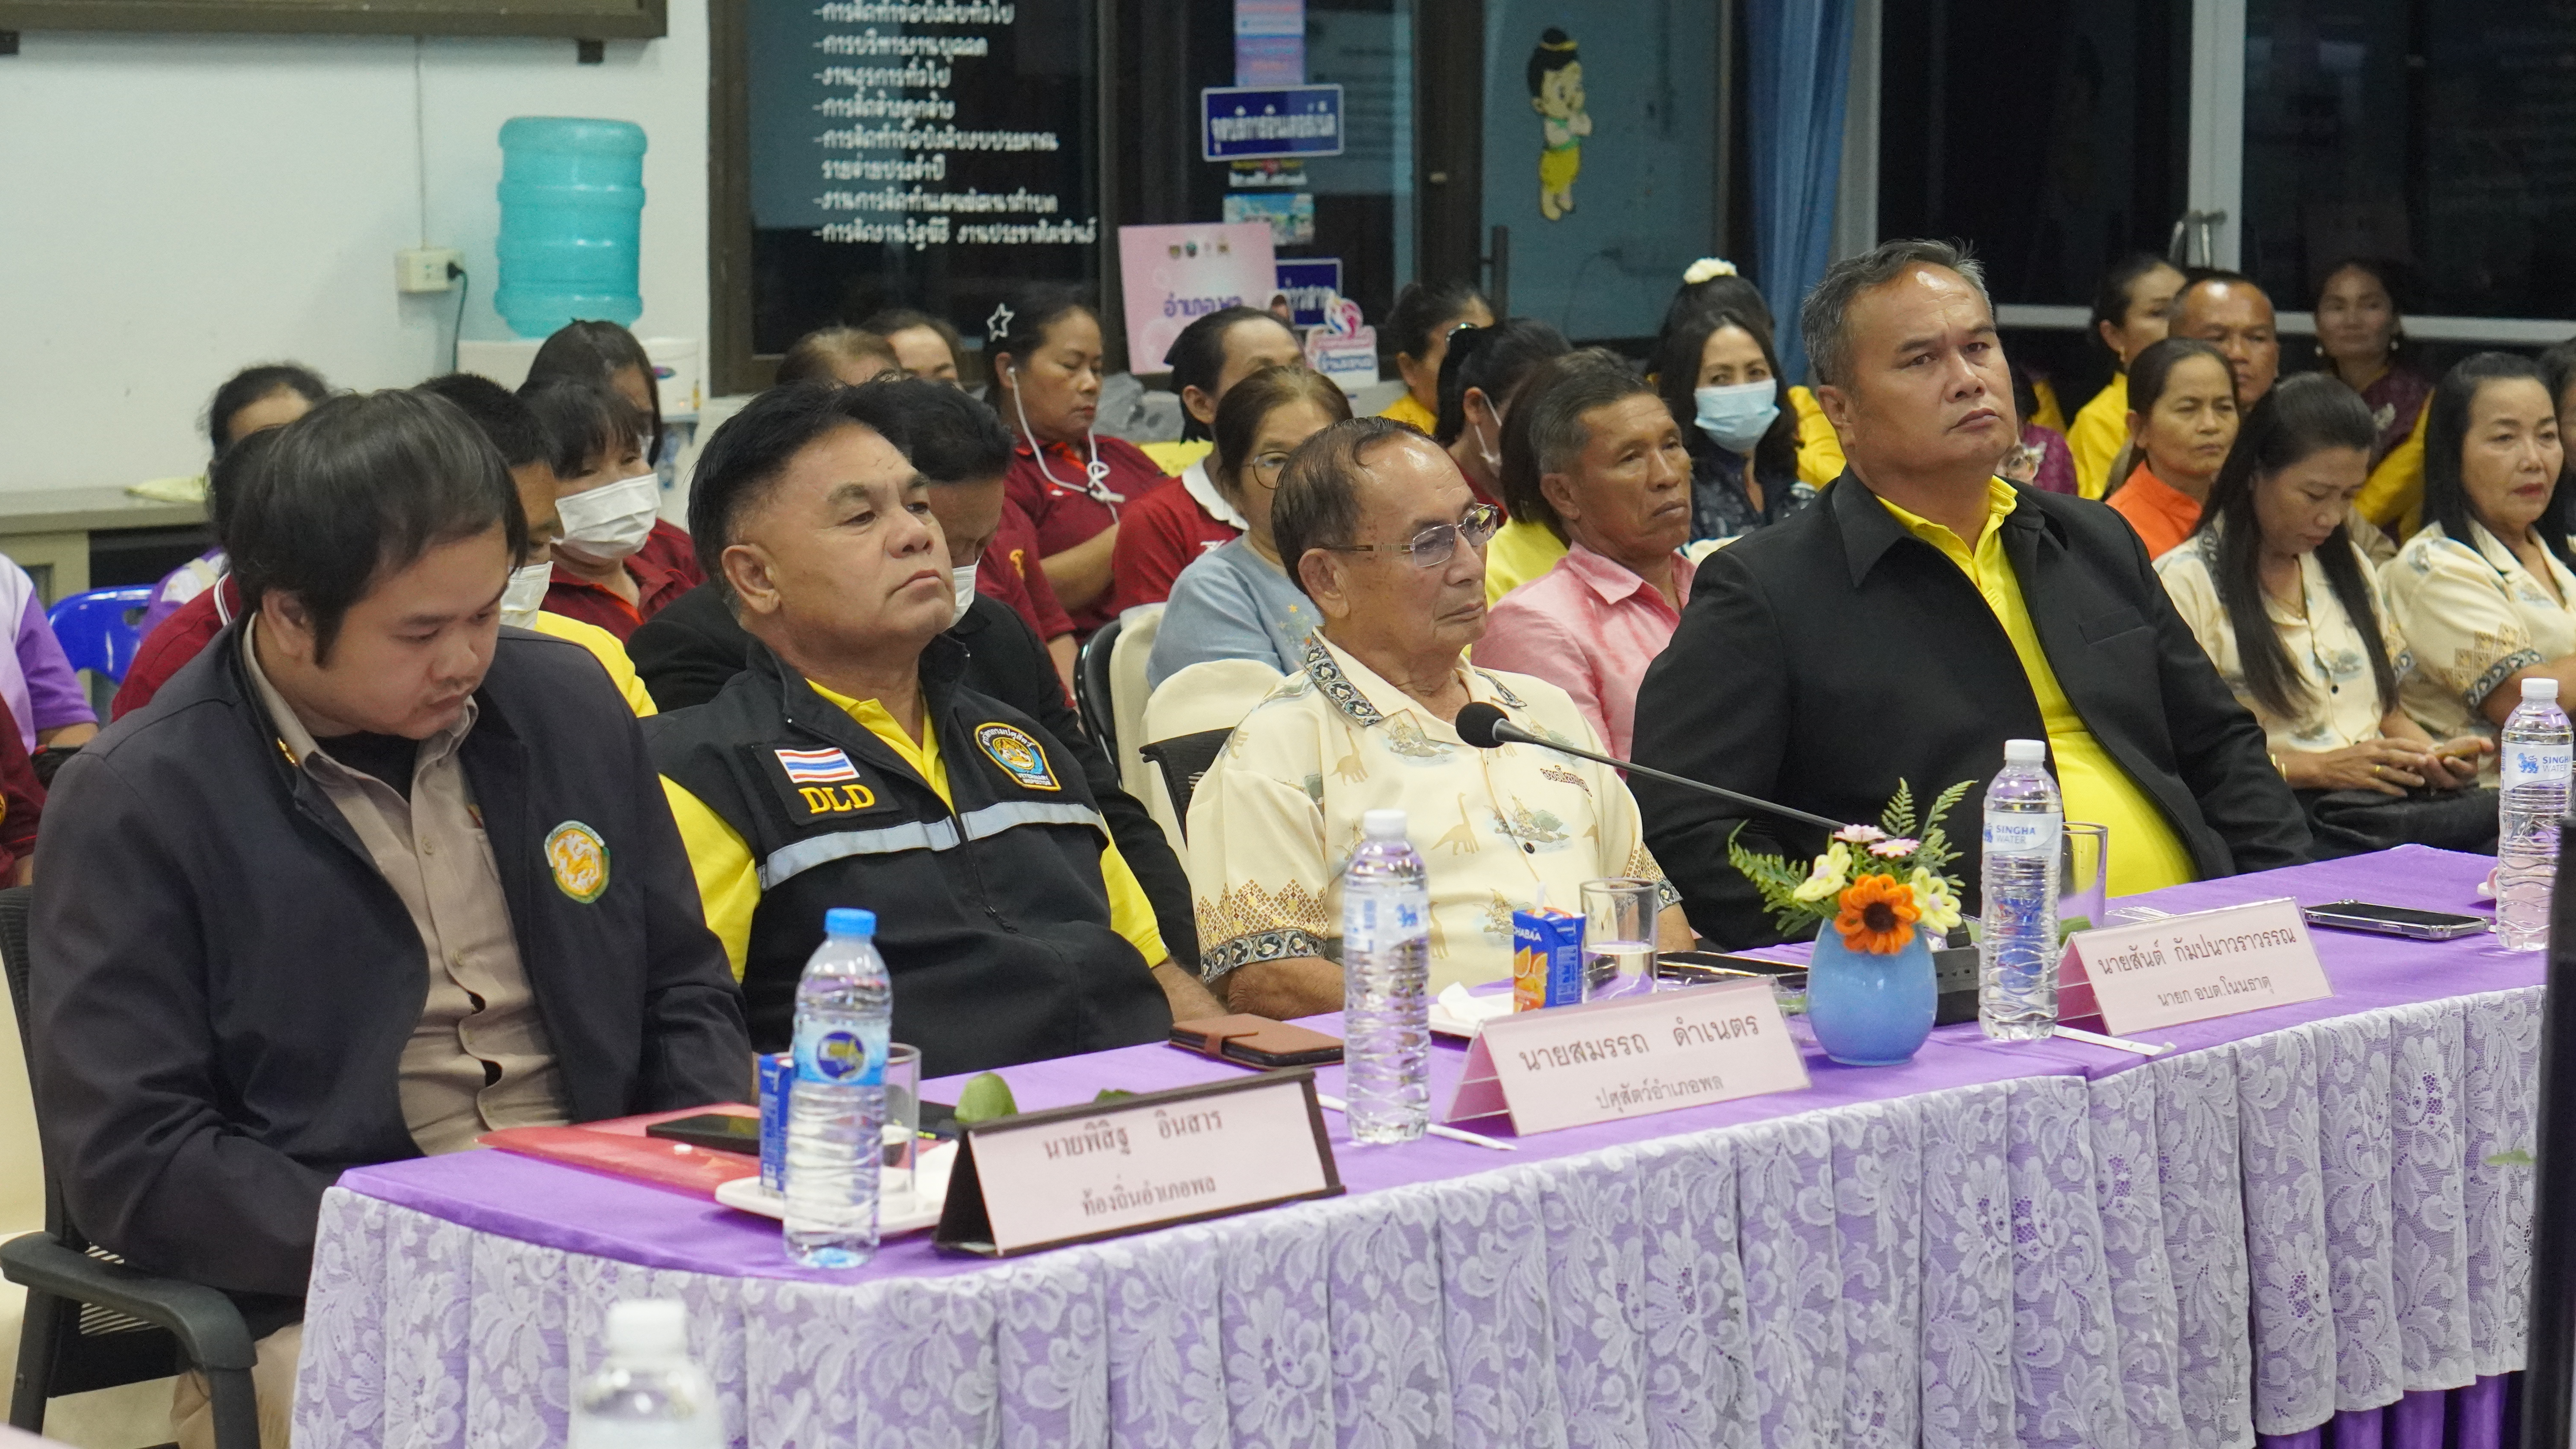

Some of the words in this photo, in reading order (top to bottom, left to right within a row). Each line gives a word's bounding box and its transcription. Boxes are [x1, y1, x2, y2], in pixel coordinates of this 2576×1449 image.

[798, 784, 875, 814] DLD
[1996, 825, 2036, 835] SINGHA
[1996, 835, 2026, 844] WATER
[2098, 939, 2166, 974] นายสันต์
[2173, 927, 2297, 963] กัมปนาวราวรรณ
[2158, 989, 2192, 1006] นายก
[2194, 975, 2275, 1000] อบต.โนนธาตุ
[1519, 1032, 1649, 1071] นายสมรรถ
[1673, 1015, 1759, 1047] ดำเนตร
[1596, 1074, 1724, 1114] ปศุสัตว์อำเภอพล
